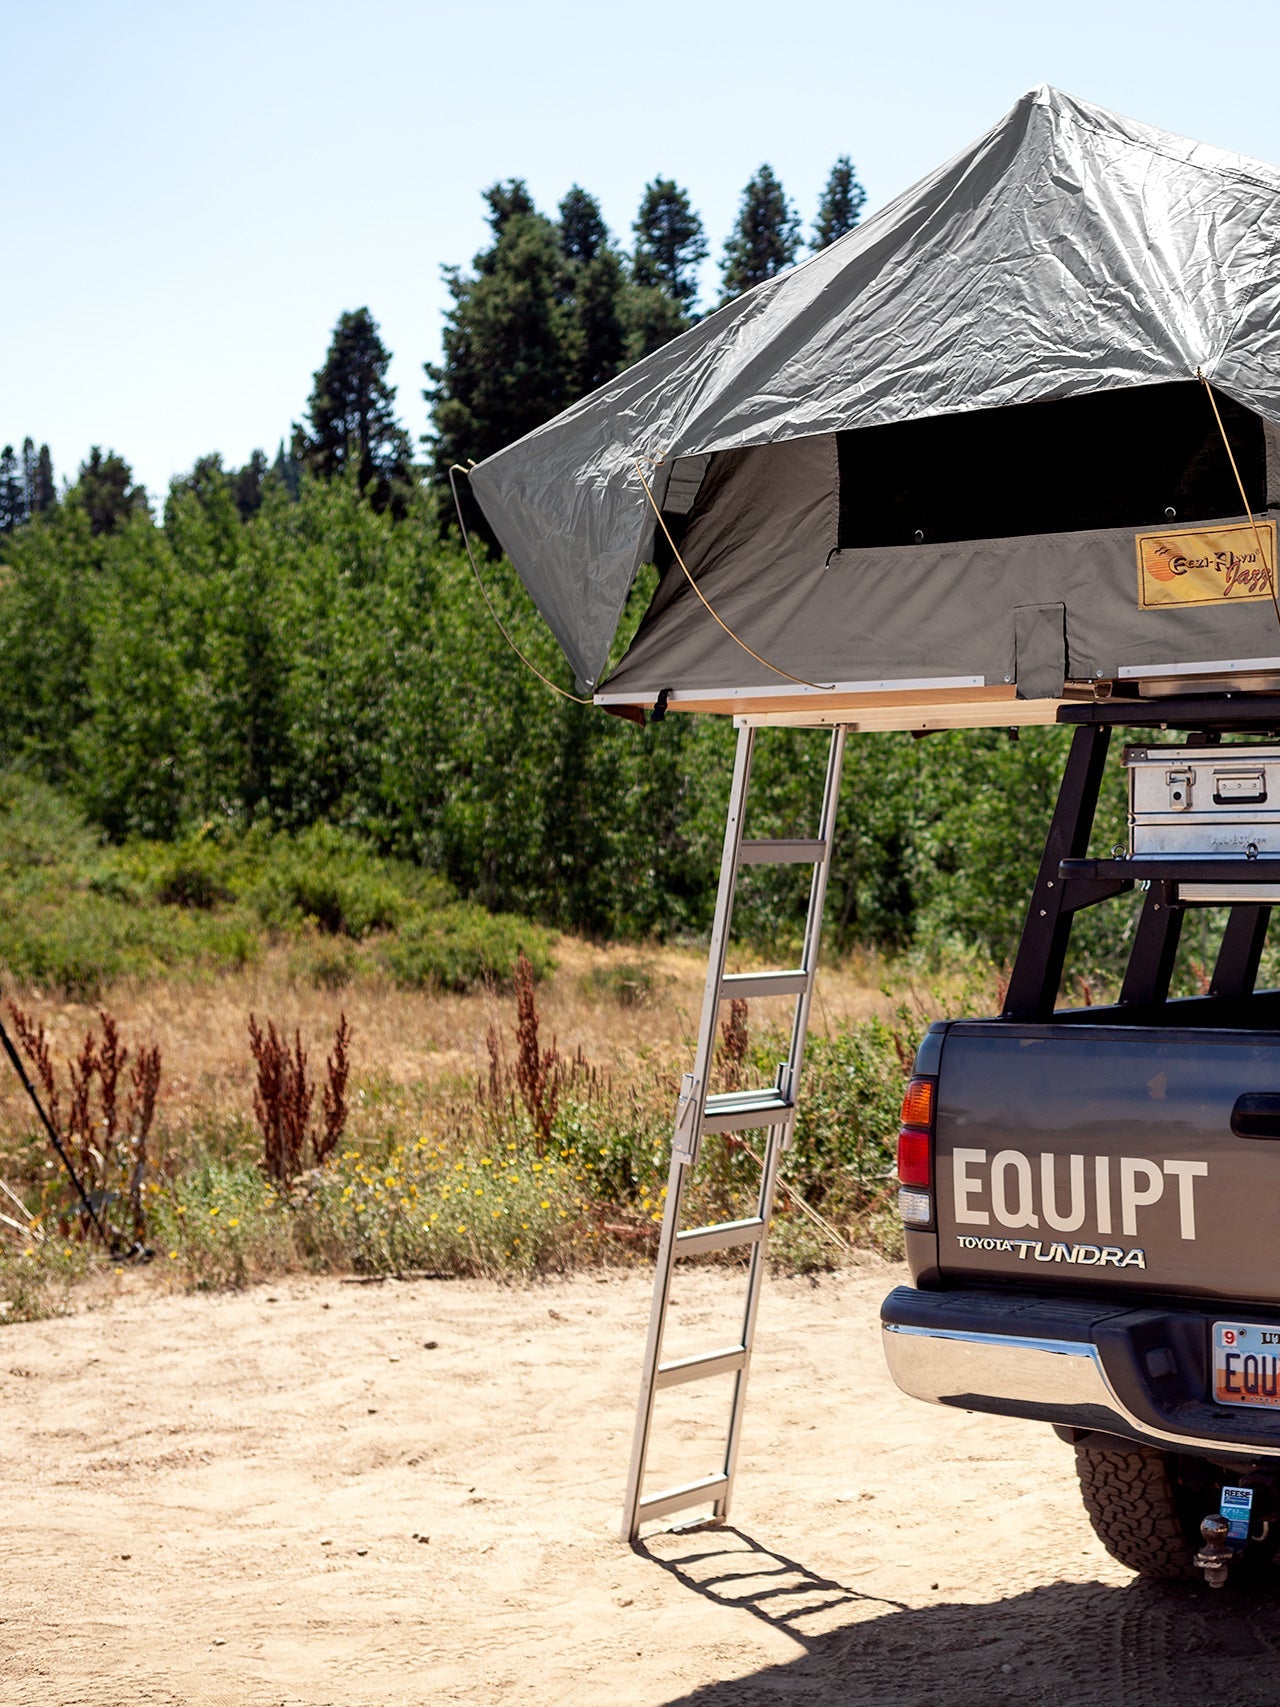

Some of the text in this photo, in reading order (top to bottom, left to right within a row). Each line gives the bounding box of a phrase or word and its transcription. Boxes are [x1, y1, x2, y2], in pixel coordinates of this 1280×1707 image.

[1223, 561, 1273, 596] Jazz
[953, 1147, 1208, 1240] EQUIPT
[956, 1235, 1147, 1270] TOYOTA TUNDRA
[1224, 1331, 1236, 1345] 9
[1224, 1489, 1252, 1498] REESE
